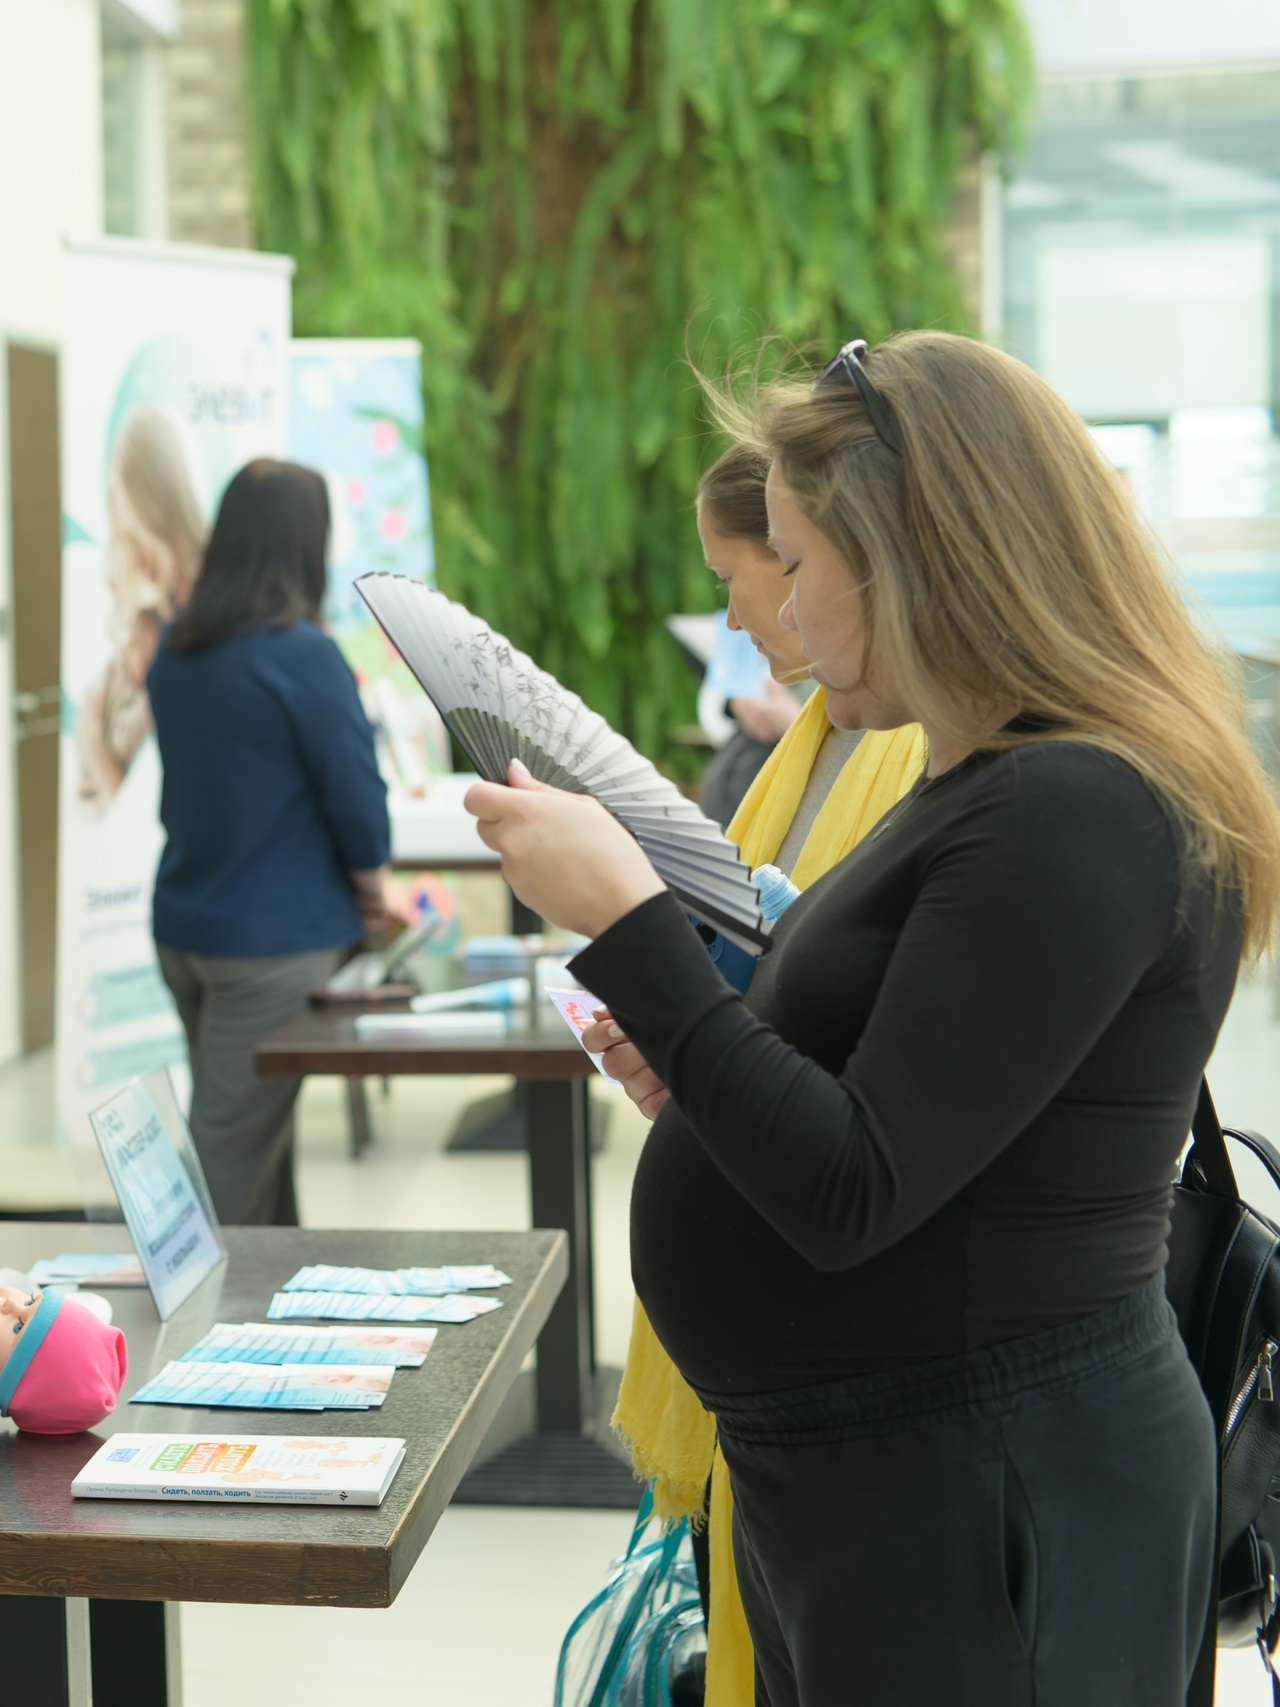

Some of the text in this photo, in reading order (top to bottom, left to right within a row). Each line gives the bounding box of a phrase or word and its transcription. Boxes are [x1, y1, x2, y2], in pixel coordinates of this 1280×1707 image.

[161, 1486, 190, 1496] Сидеть,
[191, 1488, 223, 1497] ползать,
[224, 1489, 251, 1497] ходить
